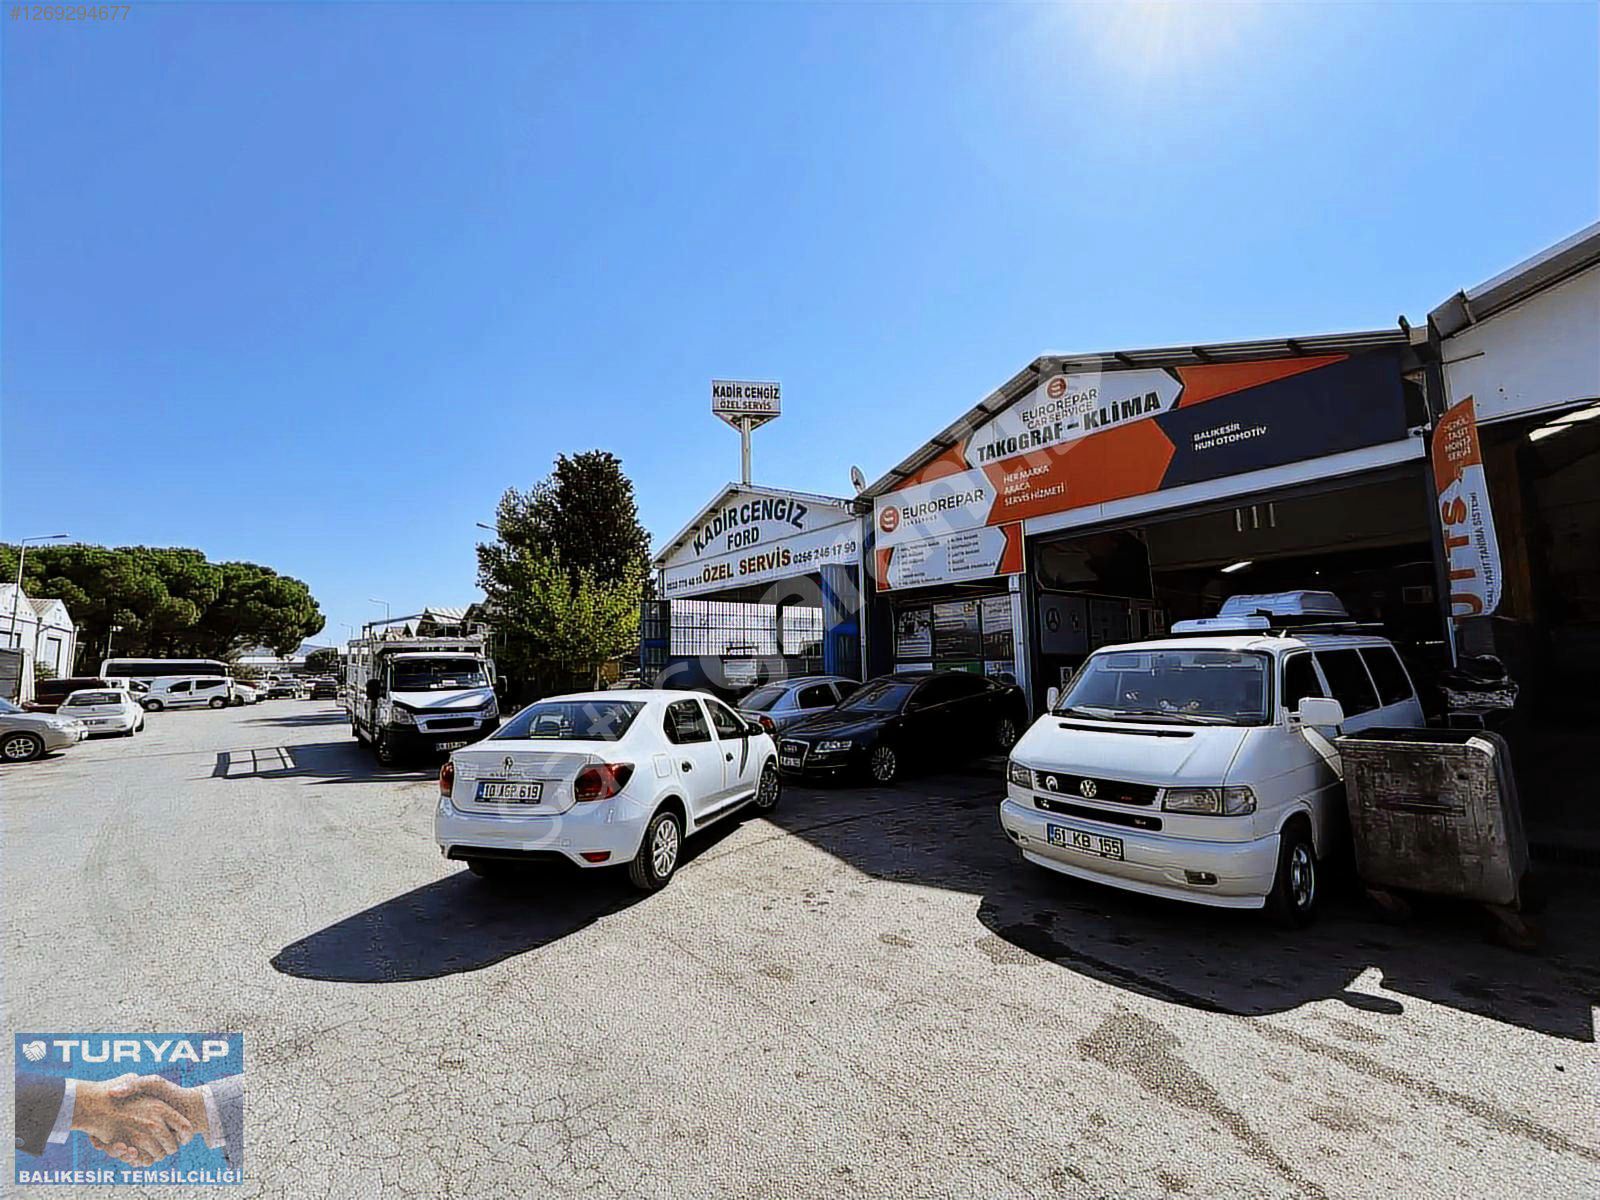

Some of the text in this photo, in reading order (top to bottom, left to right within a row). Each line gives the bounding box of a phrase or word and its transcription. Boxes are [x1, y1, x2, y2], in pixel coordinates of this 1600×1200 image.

[712, 384, 780, 399] KADİR CENGİZ
[720, 400, 772, 410] ÖZEL SERVİS
[1022, 388, 1097, 422] EUROREPAR
[1028, 401, 1093, 429] CAR SERVICE
[977, 423, 1063, 462] TAKOGRAF
[1084, 391, 1161, 431] KLİMA
[1193, 422, 1240, 441] BALIKESİR
[1194, 426, 1267, 451] NUN OTOMOTİV
[902, 489, 984, 520] EUROREPAR
[692, 496, 808, 556] KADİR CENGİZ
[727, 526, 760, 550] FORD
[702, 546, 791, 583] ÖZEL SERVİS
[485, 784, 495, 797] 10
[520, 785, 538, 798] 619
[1073, 832, 1091, 848] KB
[1099, 837, 1120, 854] 155
